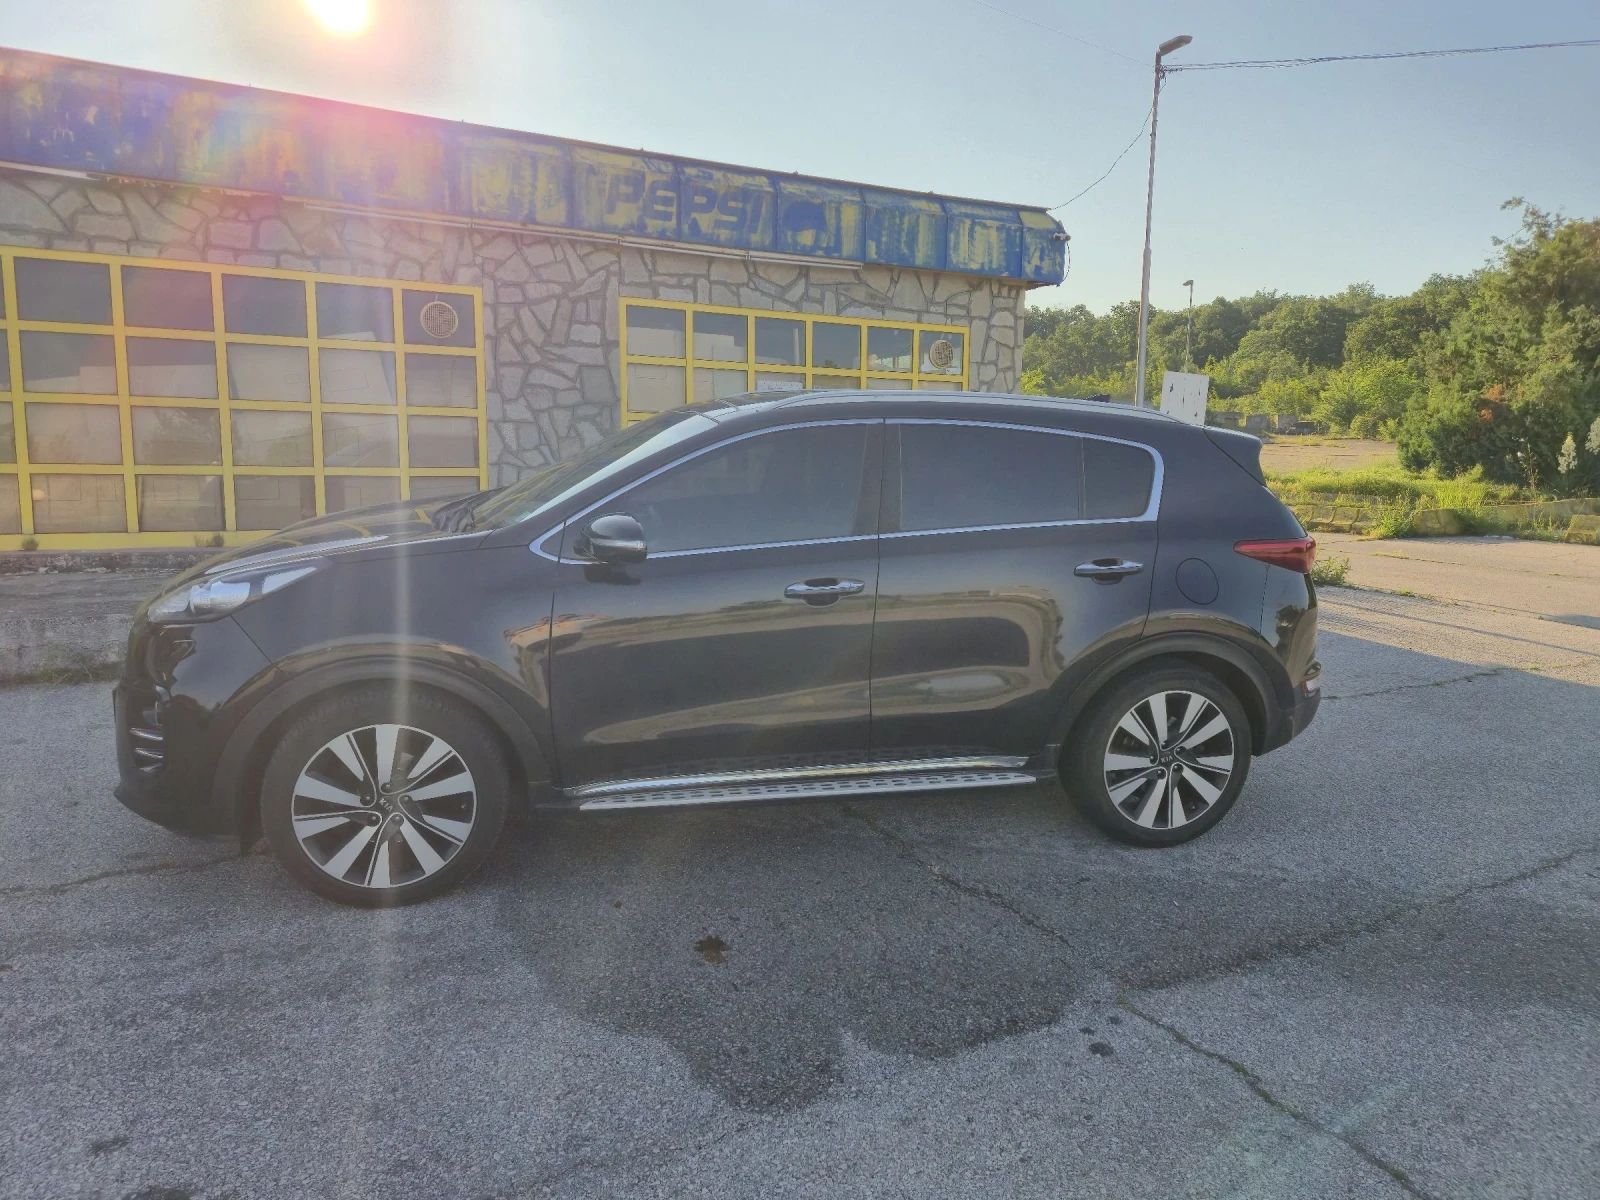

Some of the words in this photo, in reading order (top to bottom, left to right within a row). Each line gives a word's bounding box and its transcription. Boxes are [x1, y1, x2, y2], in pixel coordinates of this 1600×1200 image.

[606, 172, 766, 236] PEPSI
[1160, 755, 1173, 763] KIA
[379, 797, 393, 812] KIA
